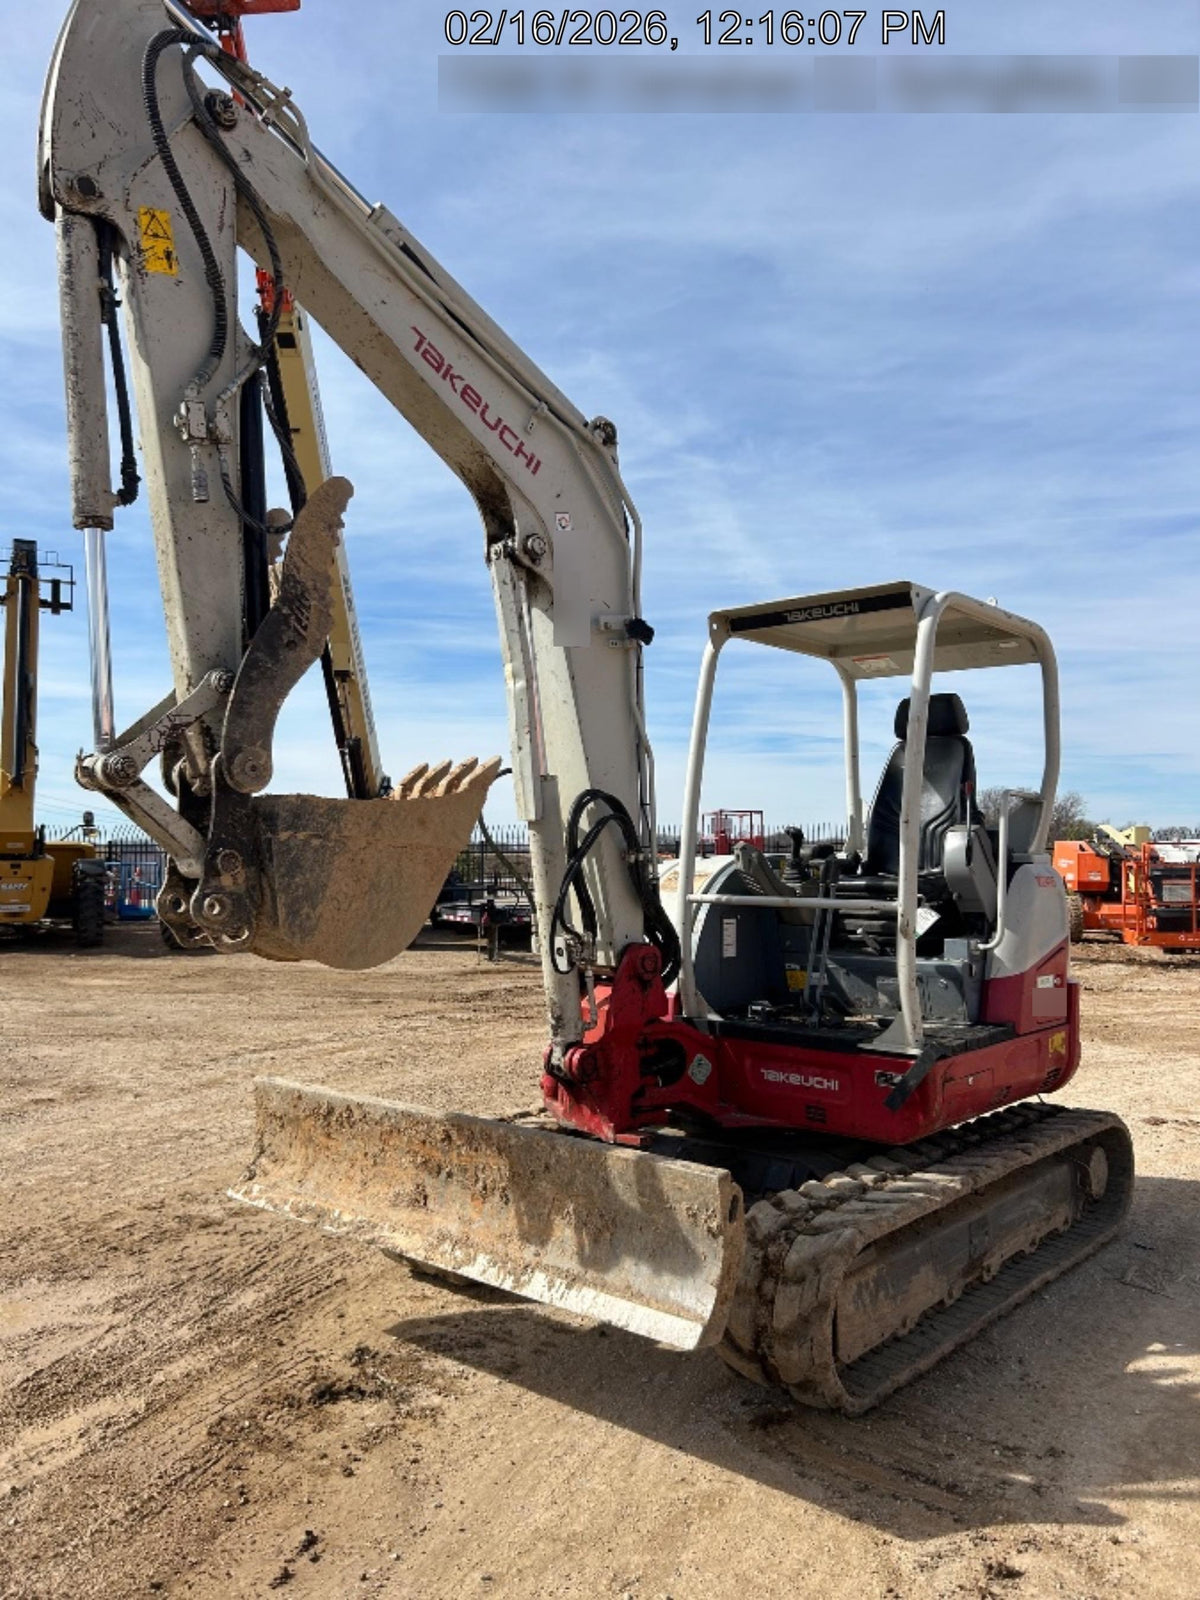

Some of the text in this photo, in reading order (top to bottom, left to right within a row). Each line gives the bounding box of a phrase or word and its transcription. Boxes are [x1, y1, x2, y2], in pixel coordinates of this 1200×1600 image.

[410, 325, 542, 476] TAKEUCHI
[783, 601, 860, 623] TAKEUCHI
[760, 1067, 839, 1092] TAKEUCHI
